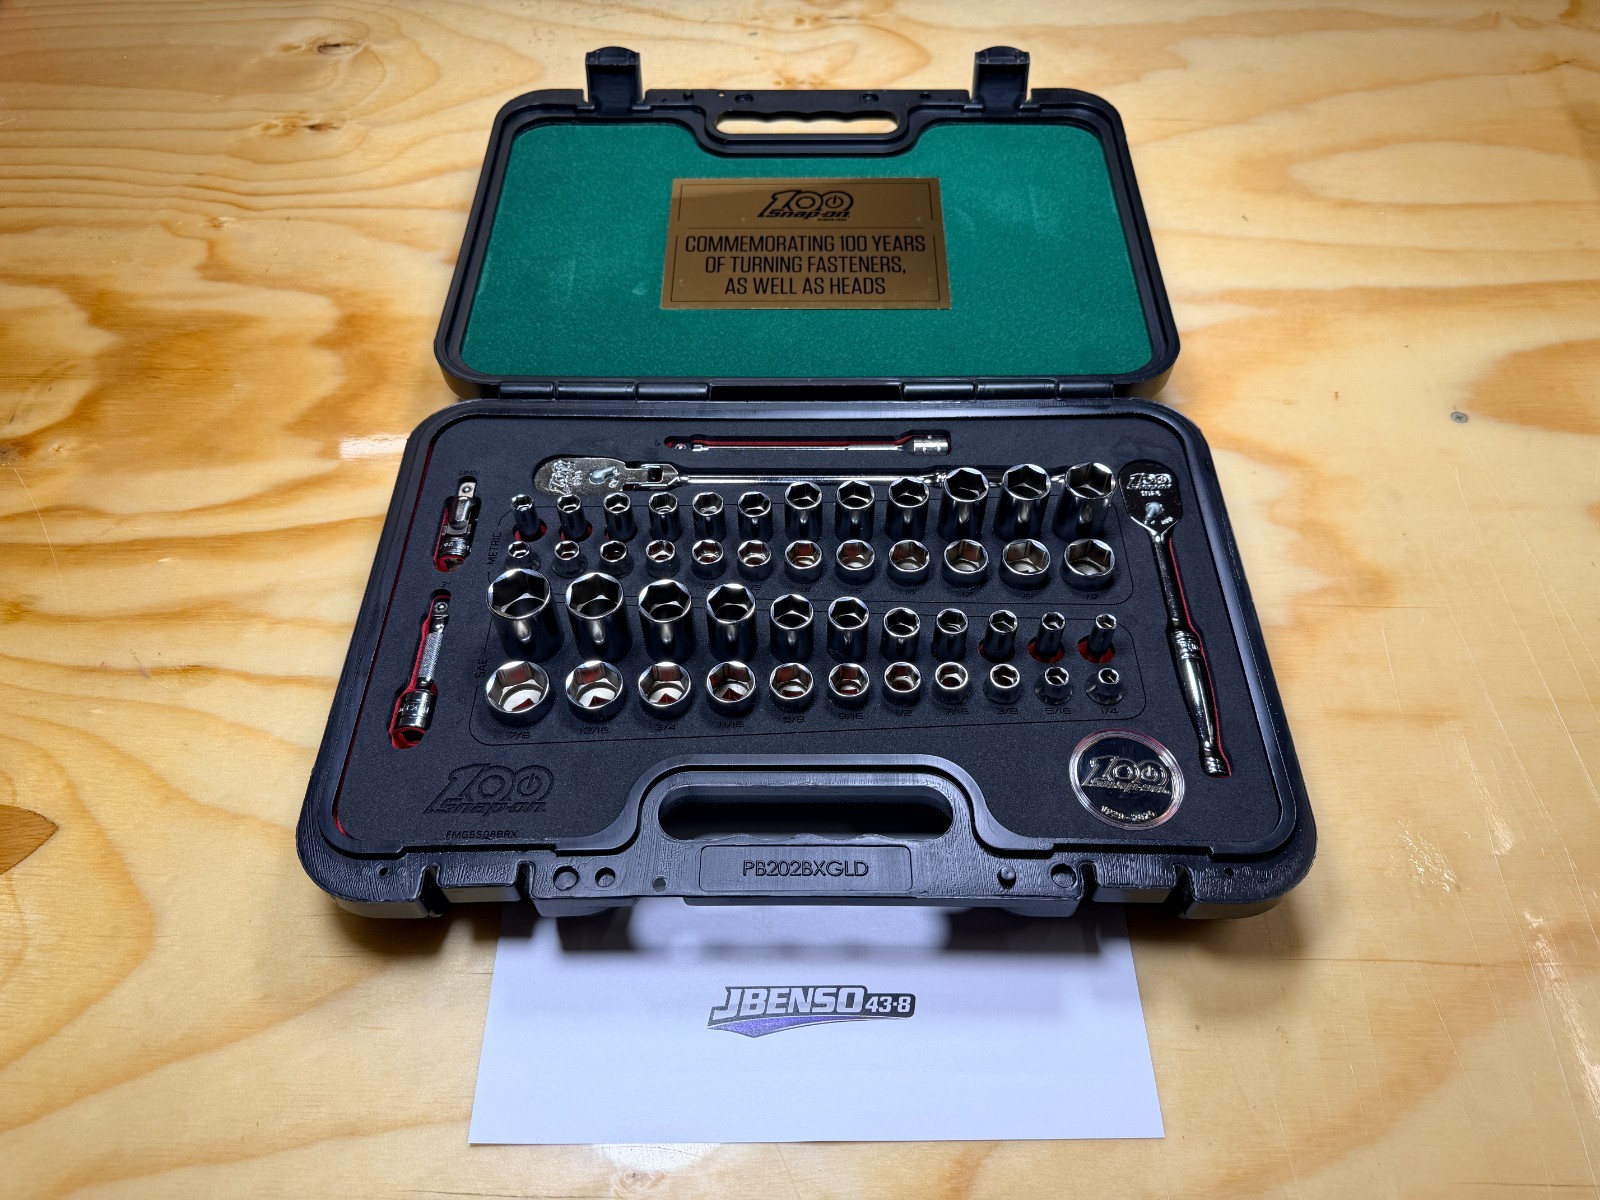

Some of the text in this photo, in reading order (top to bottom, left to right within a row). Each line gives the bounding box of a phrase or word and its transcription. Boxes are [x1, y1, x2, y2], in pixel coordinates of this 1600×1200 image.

[757, 189, 854, 218] 100
[685, 235, 926, 253] COMMEMORATING 100 YEARS
[705, 256, 907, 275] OF TURNING FASTENERS,
[725, 277, 886, 295] AS WELL AS HEADS
[487, 531, 502, 566] METRIC
[475, 658, 488, 678] SAE
[742, 860, 869, 877] PB202BXGLD
[710, 986, 866, 1022] JBENSO
